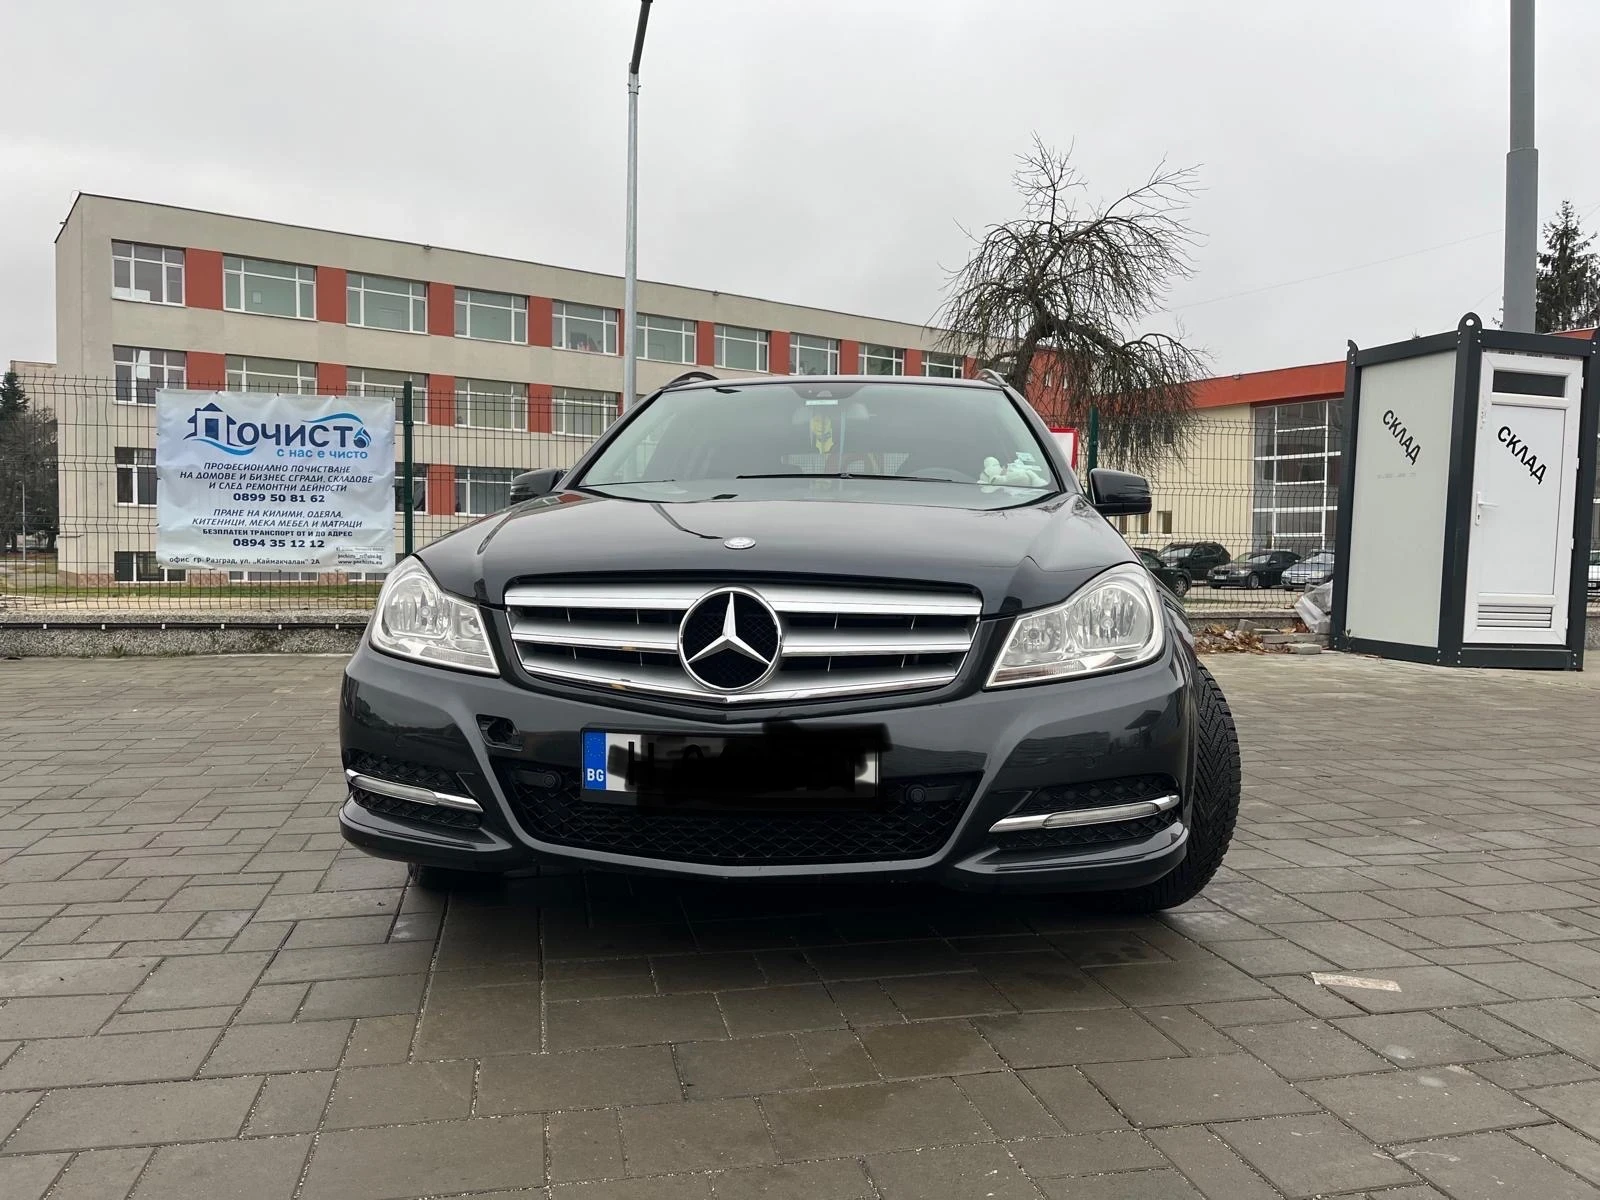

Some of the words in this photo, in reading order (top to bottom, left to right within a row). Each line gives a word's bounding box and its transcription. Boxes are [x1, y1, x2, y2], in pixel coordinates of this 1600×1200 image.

[1382, 409, 1421, 466] СКЛАД
[277, 449, 284, 457] с
[289, 449, 313, 458] нас
[329, 451, 368, 459] чисто
[1498, 426, 1546, 485] СКЛАД
[204, 463, 288, 472] ПРОФЕСИОНАЛНО
[291, 465, 350, 473] ПОЧИСТВАНЕ
[196, 472, 236, 480] ДОМОВЕ
[327, 475, 373, 483] СКЛАДОВЕ
[219, 482, 243, 490] СЛЕД
[246, 483, 297, 491] РЕМОНТНИ
[300, 483, 347, 492] ДЕЙНОСТИ
[233, 493, 266, 502] 0899
[270, 494, 286, 502] 50
[290, 494, 306, 502] 81
[310, 494, 325, 503] 62
[213, 509, 244, 517] ПРАНЕ
[249, 519, 275, 527] МЕКА
[278, 519, 309, 527] МЕБЕЛ
[322, 520, 362, 528] МАТРАЦИ
[233, 538, 266, 547] 0894
[270, 539, 286, 547] 35
[290, 539, 306, 547] 12
[310, 540, 325, 548] 12
[587, 768, 605, 782] BG
